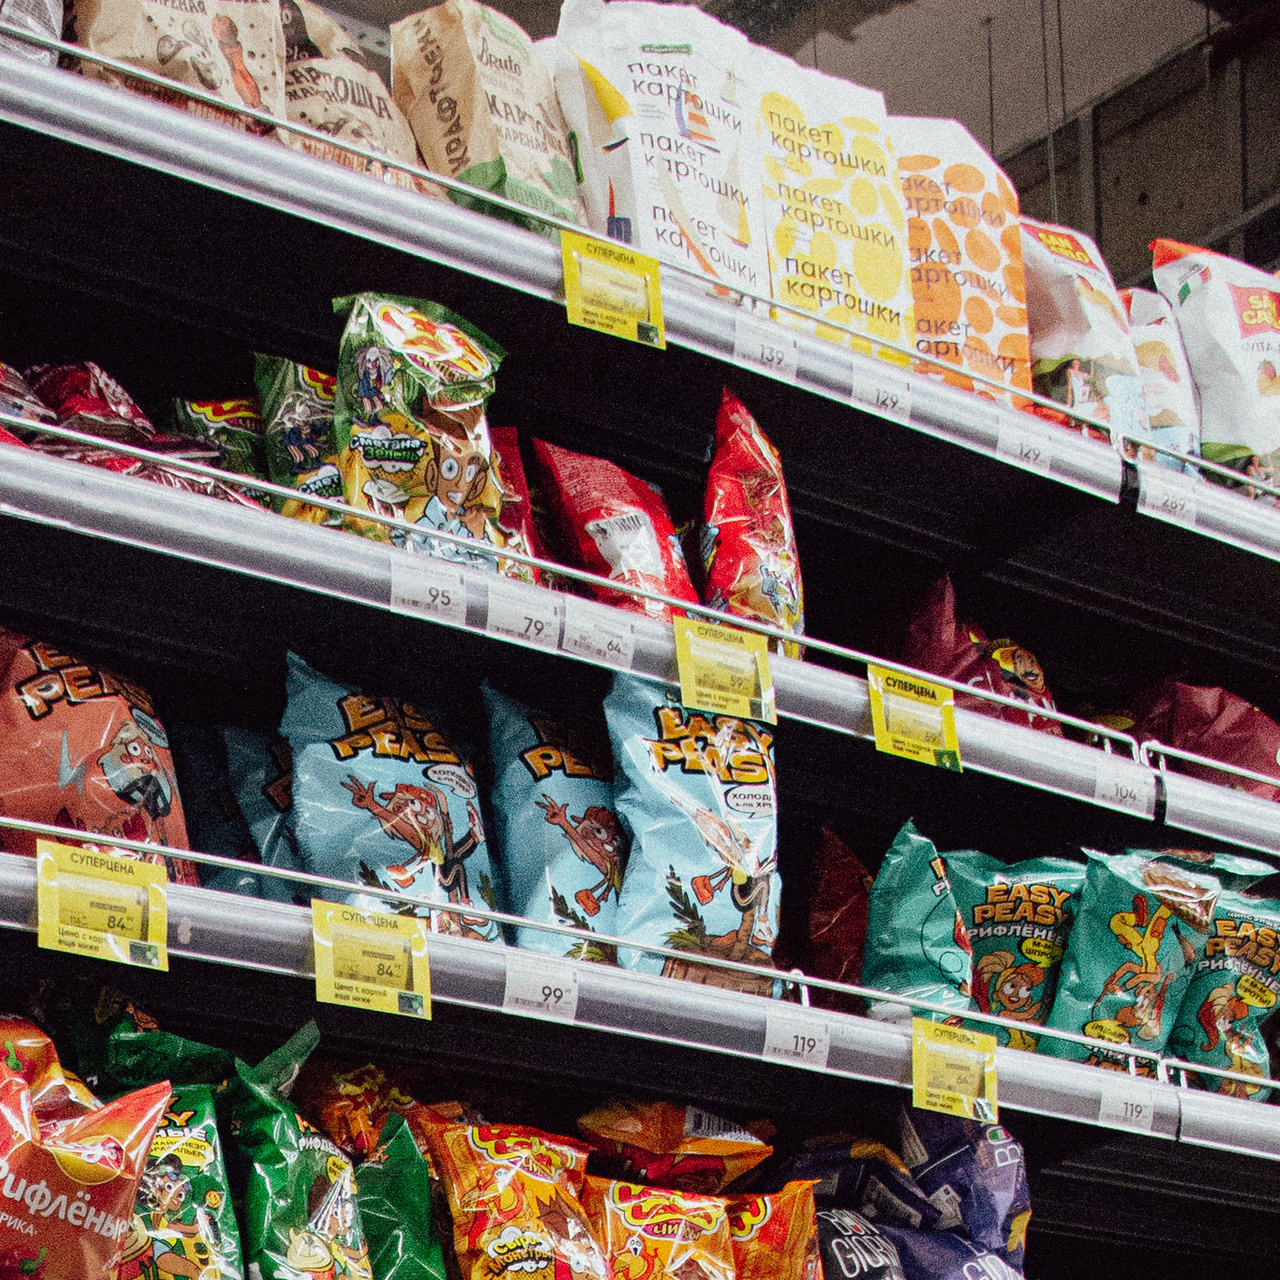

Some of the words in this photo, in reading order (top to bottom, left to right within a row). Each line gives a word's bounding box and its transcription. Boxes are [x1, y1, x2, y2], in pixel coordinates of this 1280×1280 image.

[626, 61, 697, 88] пакет
[286, 65, 395, 122] АРТОШКА
[632, 78, 743, 134] картошки
[768, 110, 833, 146] пакет
[639, 132, 707, 168] пакет
[771, 131, 887, 177] картошки
[900, 176, 952, 196] акет
[778, 183, 844, 216] пакет
[781, 204, 896, 250] картошки
[908, 246, 962, 266] акет
[785, 256, 854, 288] пакет
[787, 278, 902, 327] картошки
[915, 317, 971, 337] акет
[759, 344, 785, 365] 139
[874, 389, 899, 409] 129
[1018, 442, 1041, 462] 129
[428, 587, 451, 607] 95
[523, 617, 545, 636] 79
[697, 626, 745, 645] СУПЕРЦЕНА
[606, 640, 621, 654] 64
[885, 676, 937, 701] СУПЕРЦЕНА
[1113, 783, 1137, 803] 104
[70, 852, 135, 876] СУПЕРЦЕНА
[986, 883, 1071, 908] EASY
[107, 915, 126, 931] 84
[376, 963, 394, 978] 84
[541, 985, 564, 1004] 99
[792, 1035, 817, 1052] 119
[1123, 1102, 1143, 1119] 119
